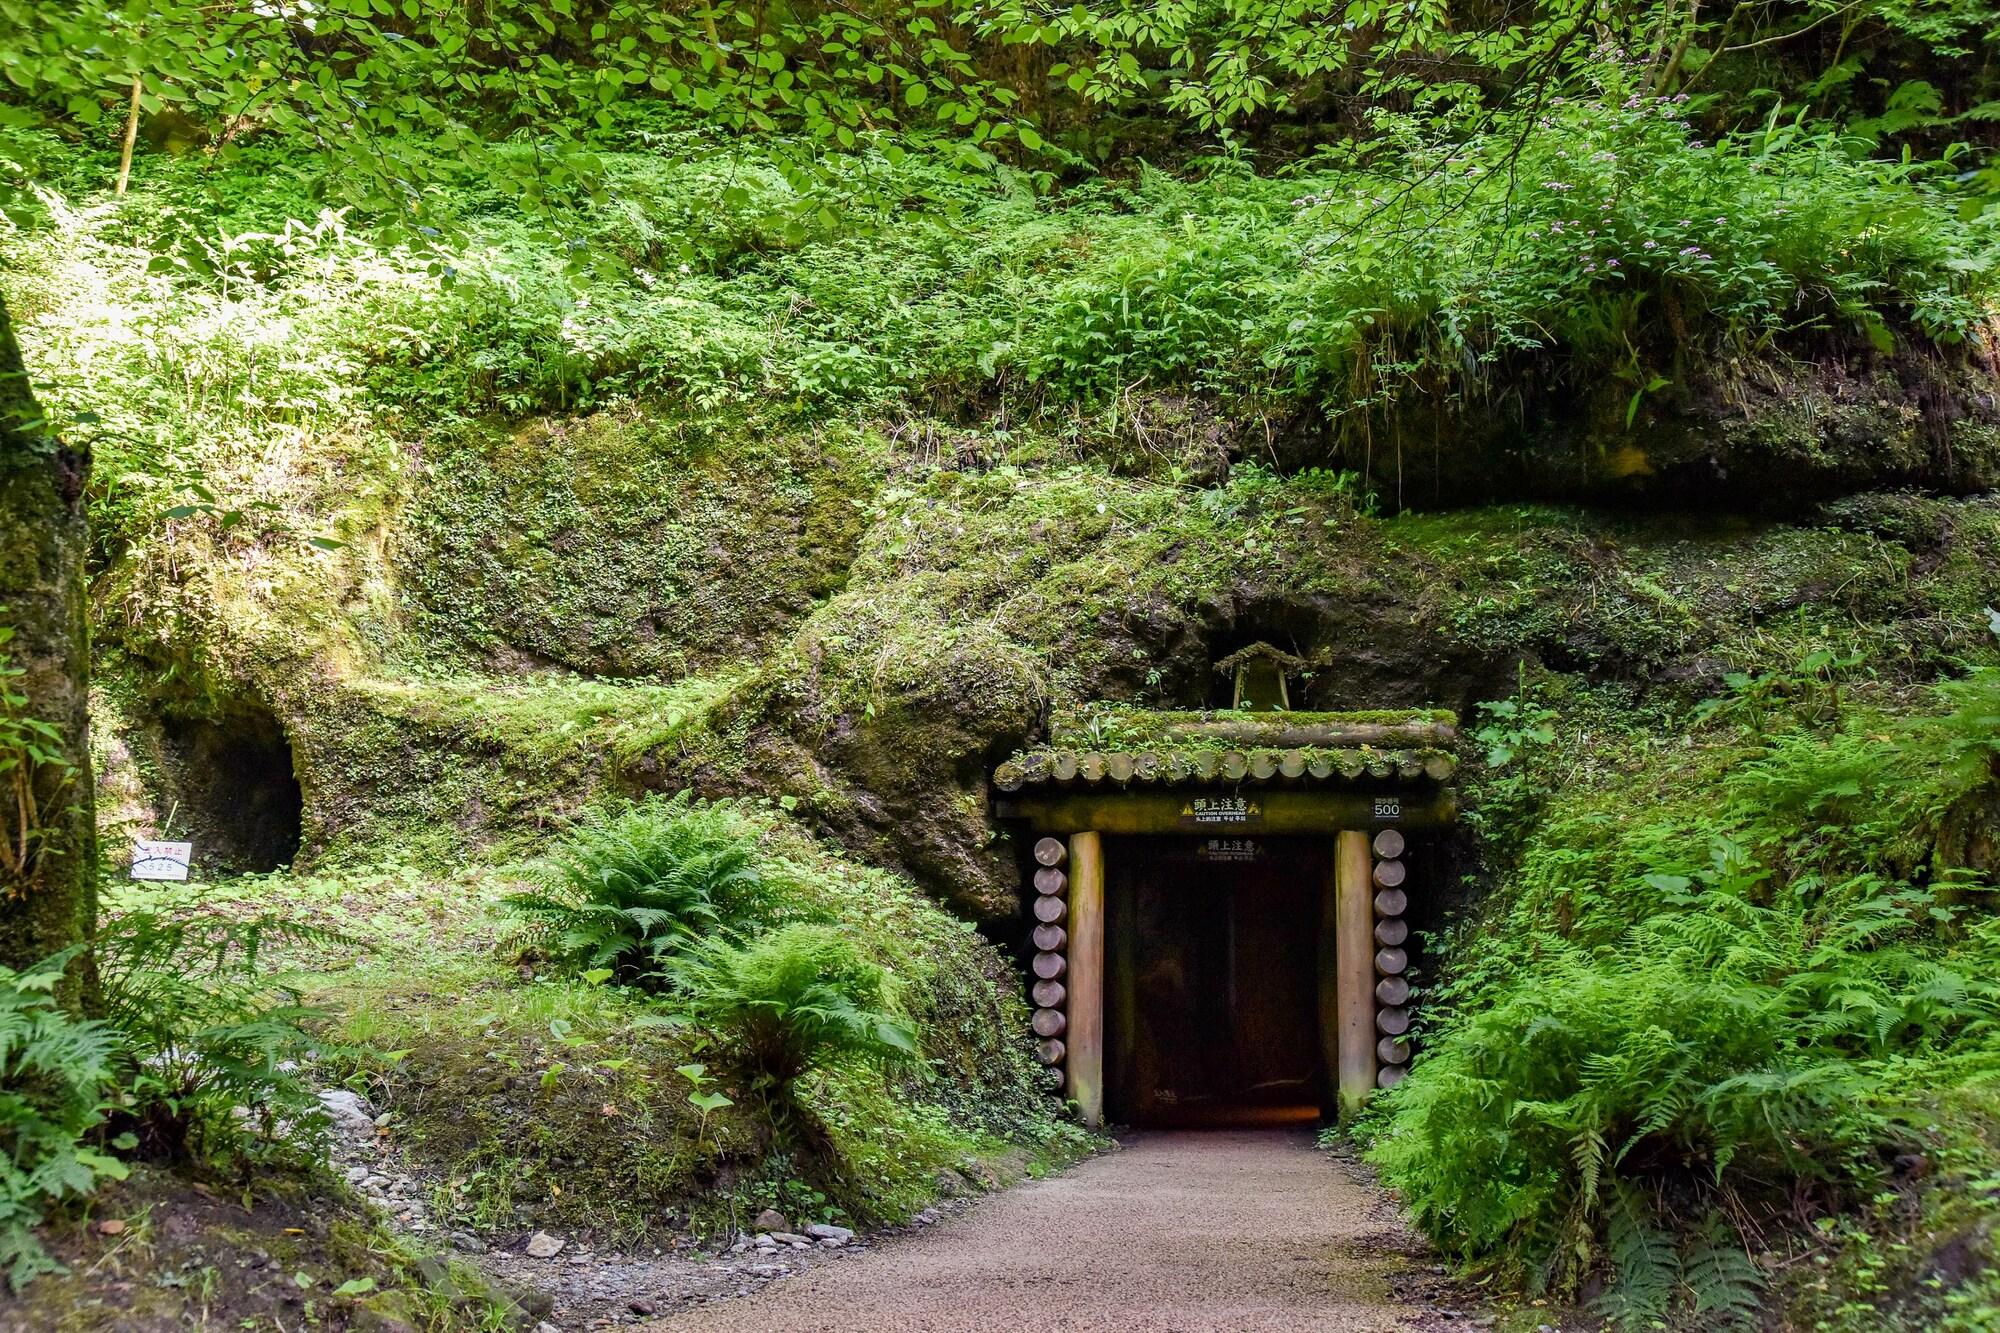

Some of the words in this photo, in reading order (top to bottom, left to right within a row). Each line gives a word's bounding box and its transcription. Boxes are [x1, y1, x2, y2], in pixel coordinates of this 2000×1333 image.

[1194, 798, 1247, 811] 頭上注意
[1375, 805, 1400, 815] 500
[1208, 839, 1255, 852] 頭上注意
[149, 863, 172, 872] 525
